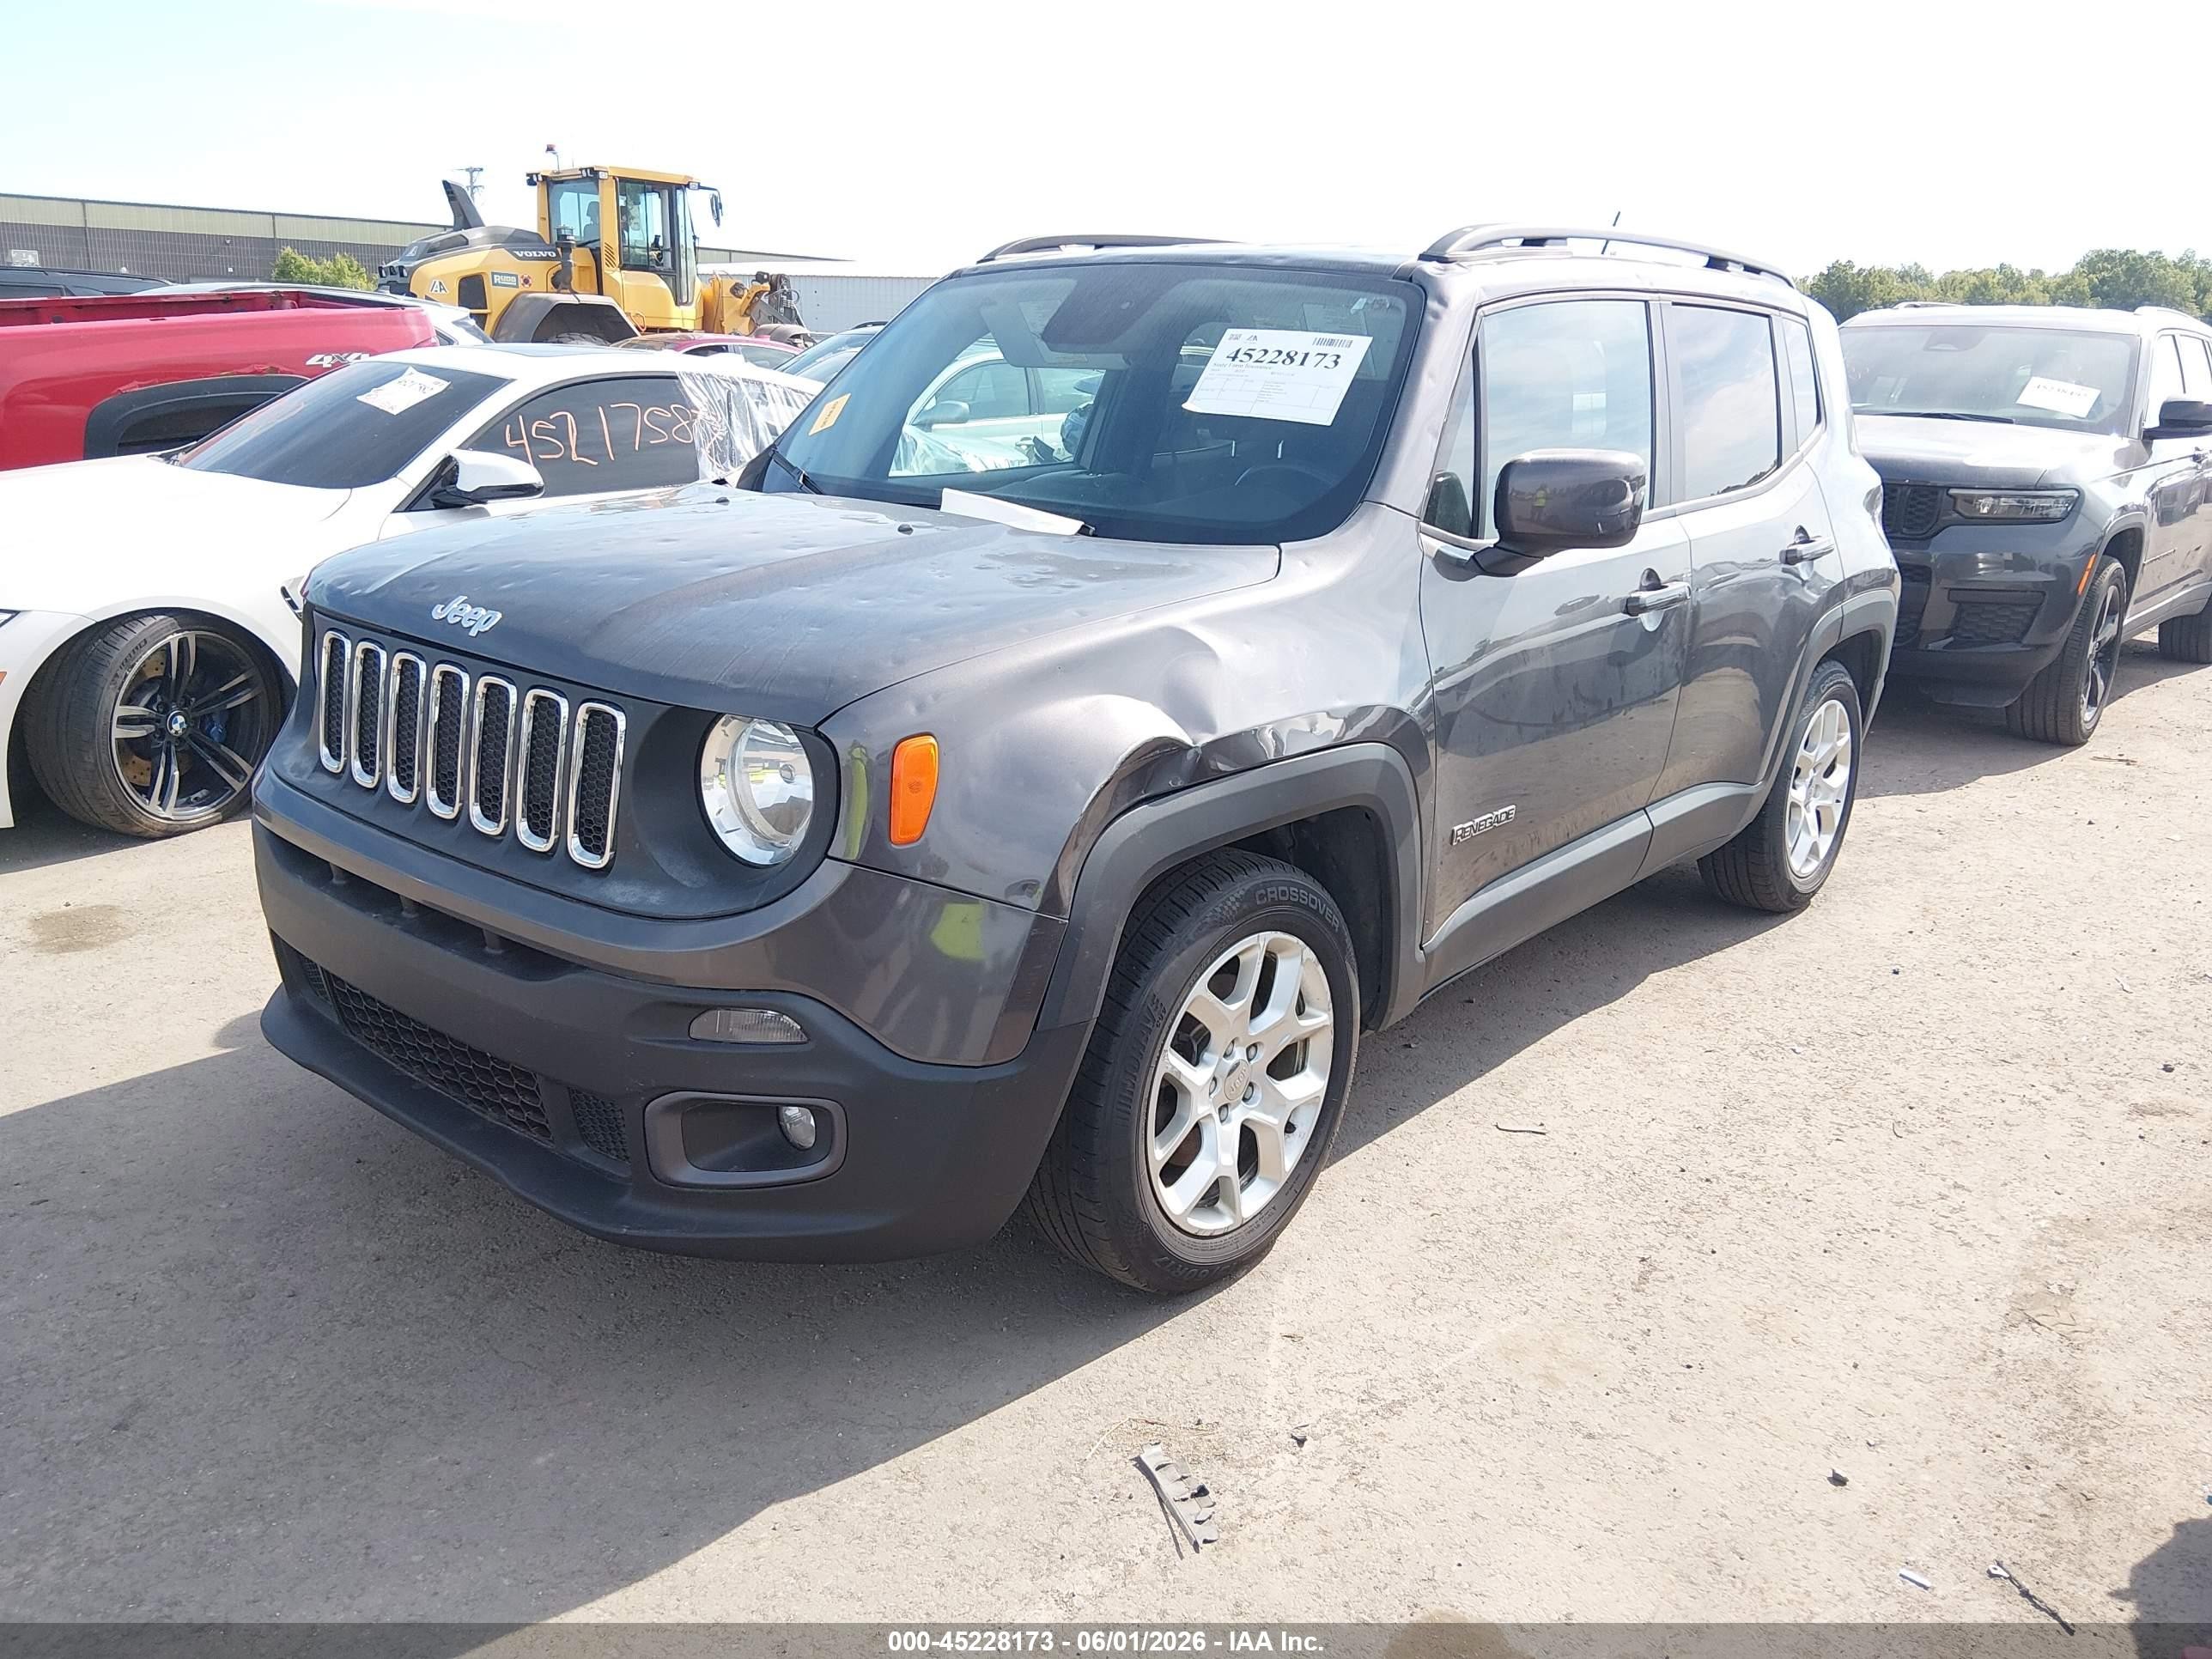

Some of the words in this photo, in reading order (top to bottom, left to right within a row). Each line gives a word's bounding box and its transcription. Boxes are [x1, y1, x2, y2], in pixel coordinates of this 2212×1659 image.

[1226, 347, 1341, 370] 45228173
[431, 595, 502, 637] Jeep
[1452, 805, 1516, 845] RENEGADE
[1255, 885, 1340, 932] CROSSOVER
